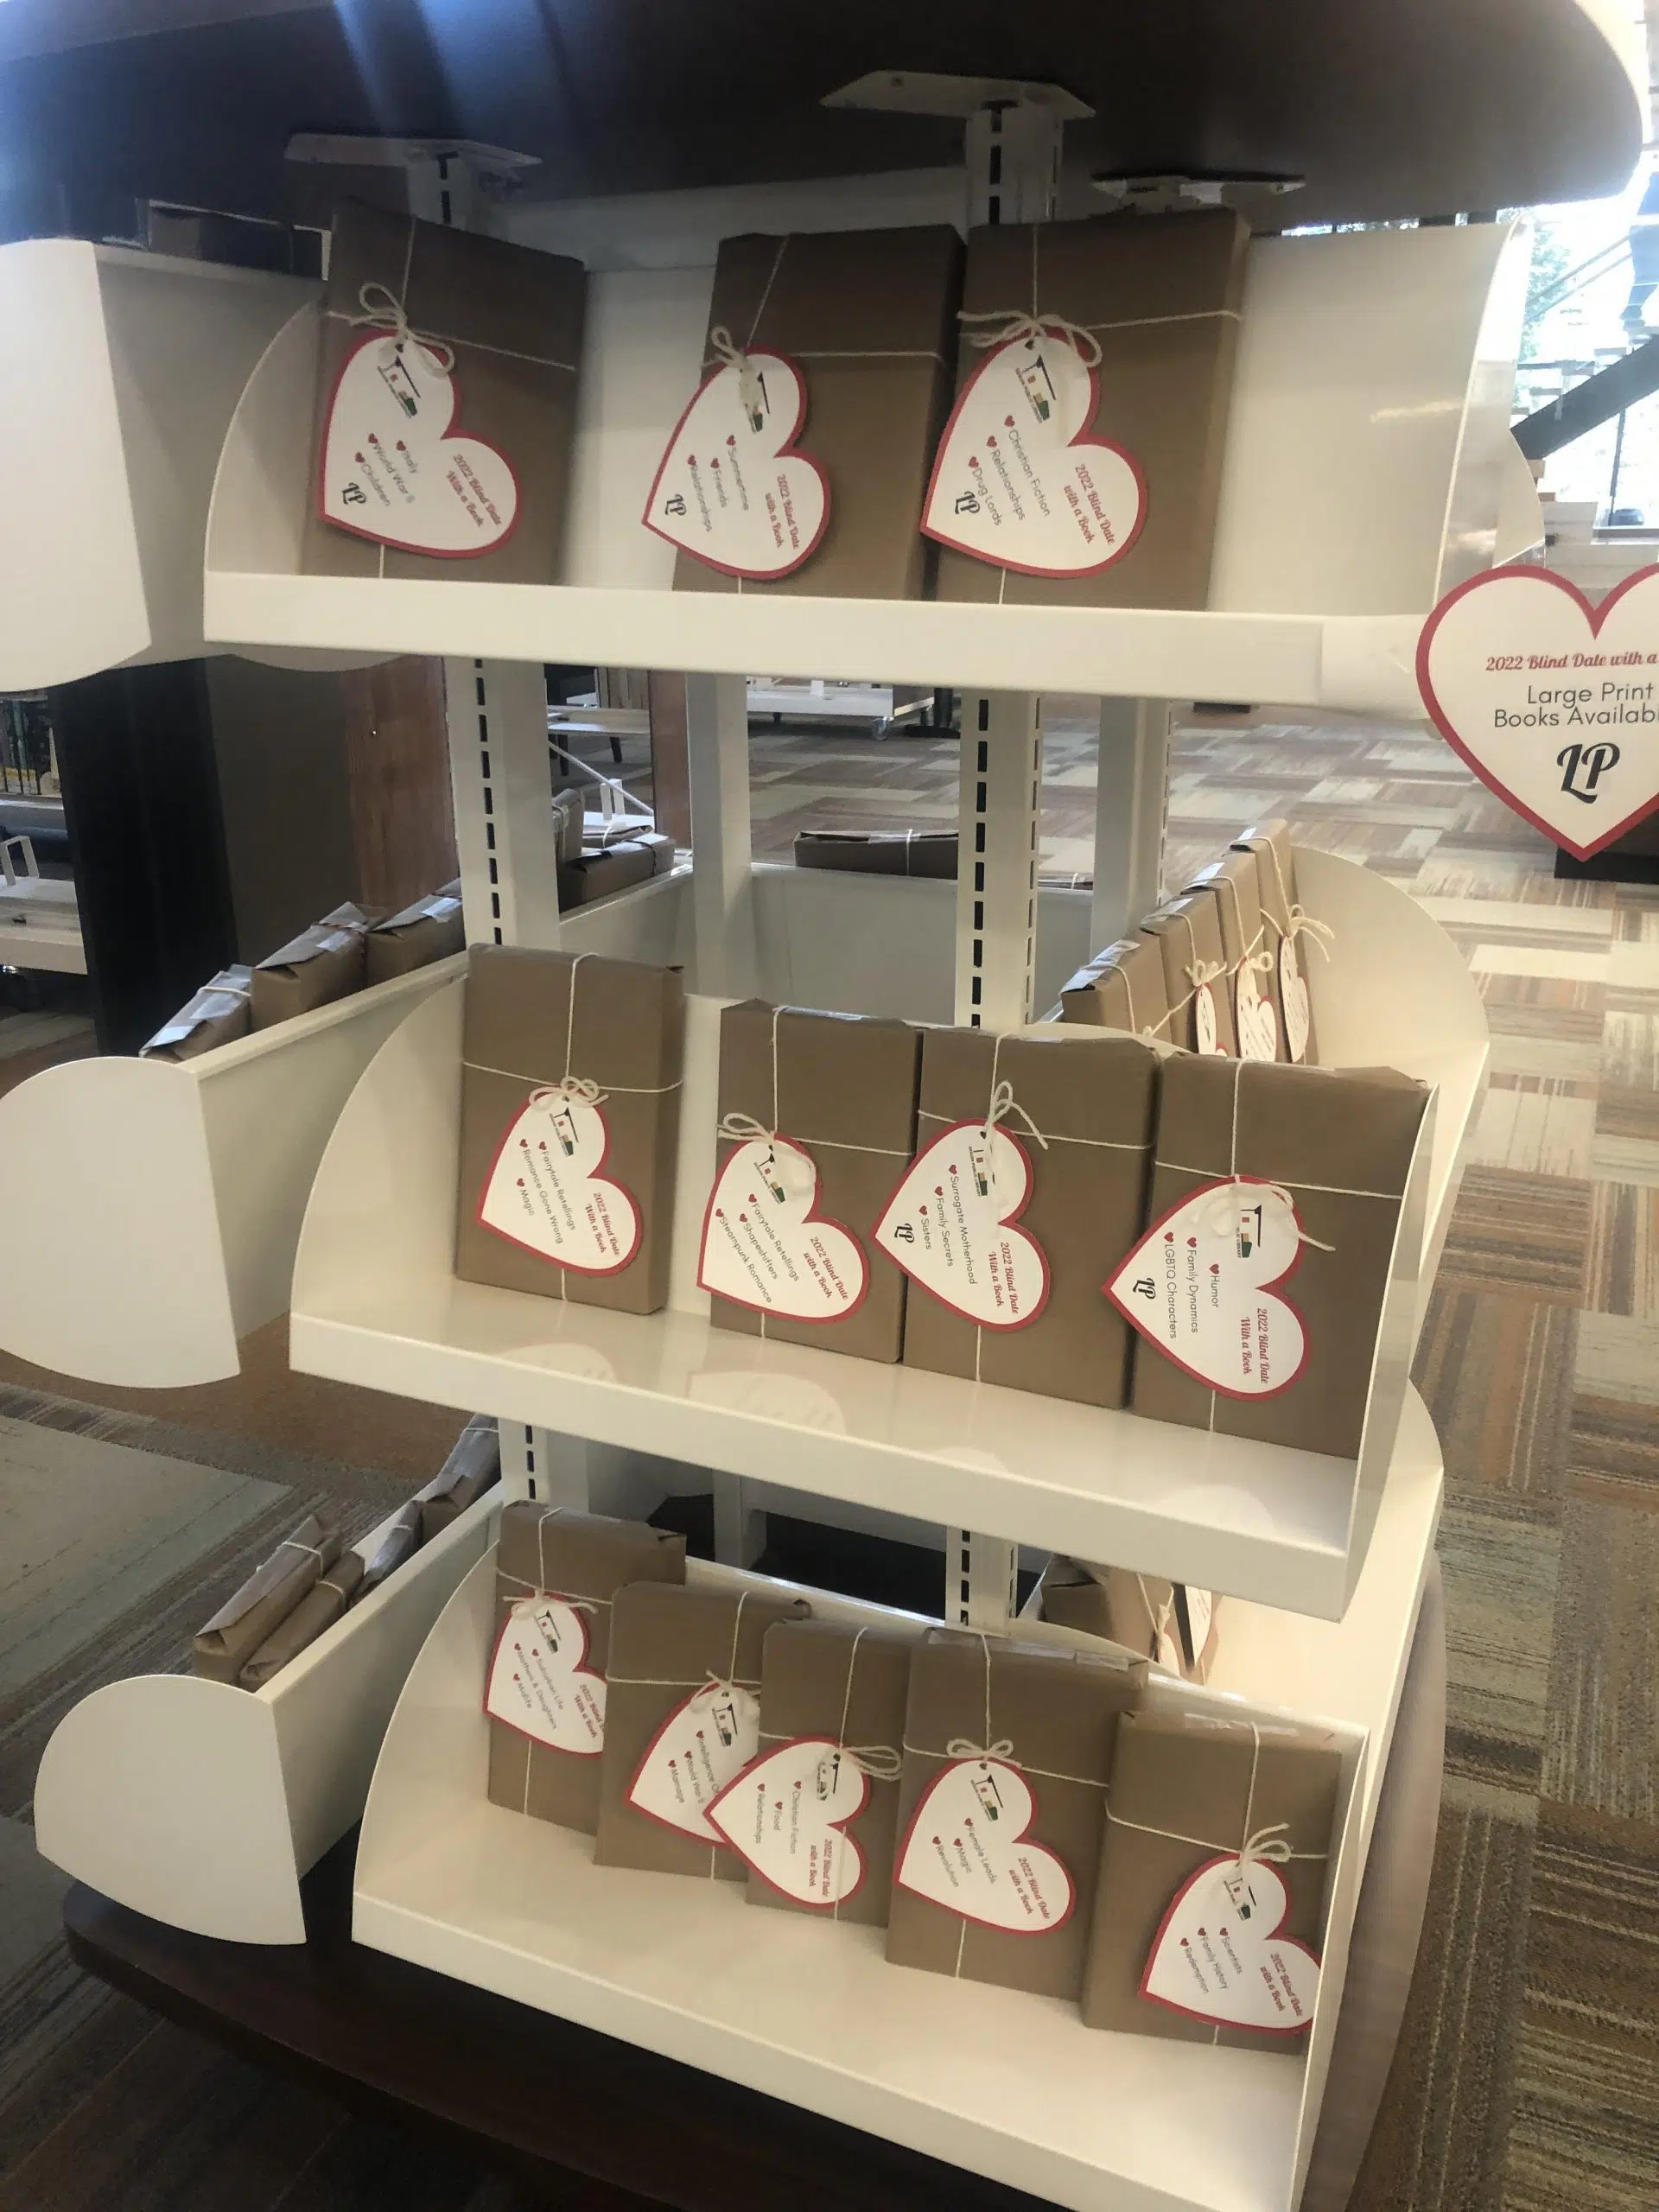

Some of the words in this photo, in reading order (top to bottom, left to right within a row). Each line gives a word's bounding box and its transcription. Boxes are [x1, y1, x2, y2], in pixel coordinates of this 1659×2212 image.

[990, 449, 1025, 520] Relationships
[1008, 429, 1033, 478] Christian
[1030, 478, 1050, 516] Fiction
[342, 483, 366, 505] LP
[664, 494, 687, 516] LP
[955, 491, 980, 515] LP
[972, 467, 988, 496] Drug
[985, 495, 1002, 525] Lords
[1076, 464, 1093, 491] 2022
[1088, 491, 1106, 520] Blind
[1100, 519, 1115, 544] Date
[1064, 486, 1078, 508] with
[1078, 516, 1095, 543] Book
[1486, 656, 1523, 671] 2022
[1528, 655, 1567, 670] Blind
[1573, 653, 1606, 667] Date
[1611, 652, 1643, 666] with
[1647, 653, 1657, 664] a
[1528, 685, 1592, 709] Large
[1602, 683, 1654, 701] Print
[1494, 707, 1559, 728] Books
[1557, 742, 1620, 804] LP
[520, 1190, 534, 1215] Magic
[522, 1149, 542, 1188] Romance
[539, 1191, 551, 1214] Gone
[550, 1216, 563, 1243] Wrong
[541, 1151, 559, 1187] Fairytale
[556, 1189, 575, 1230] Retellings
[585, 1204, 596, 1224] With
[595, 1232, 606, 1253] Book
[594, 1192, 607, 1212] 2022
[601, 1214, 614, 1236] Blind
[610, 1237, 620, 1255] Date
[937, 1198, 949, 1228] Family
[950, 1176, 963, 1224] Surrogate
[960, 1227, 977, 1284] Motherhood
[743, 1223, 778, 1279] Shapeshifters
[752, 1204, 774, 1239] Fairytale
[774, 1240, 799, 1281] Retellings
[894, 1224, 914, 1243] LP
[921, 1218, 931, 1249] Sisters
[942, 1230, 953, 1266] Secrets
[720, 1217, 750, 1263] Steampunk
[747, 1263, 772, 1302] Romance
[810, 1237, 826, 1258] 2022
[823, 1258, 839, 1281] Blind
[836, 1281, 848, 1299] Date
[1001, 1243, 1012, 1264] 2022
[1165, 1244, 1176, 1279] LGBTQ
[1185, 1250, 1198, 1281] Family
[804, 1253, 817, 1269] with
[818, 1277, 832, 1298] Book
[988, 1252, 998, 1274] With
[994, 1284, 1004, 1306] Book
[1005, 1267, 1016, 1292] Blind
[1133, 1278, 1156, 1300] LP
[1211, 1275, 1220, 1307] Humor
[1009, 1294, 1019, 1313] Date
[1167, 1282, 1178, 1338] Characters
[1186, 1286, 1198, 1332] Dynamics
[1257, 1308, 1268, 1332] 2022
[1241, 1317, 1250, 1340] With
[1243, 1351, 1252, 1375] Book
[1259, 1334, 1268, 1360] Blind
[1261, 1363, 1269, 1383] Date
[936, 1844, 958, 1887] Revolution
[956, 1846, 971, 1873] Magic
[967, 1826, 984, 1857] Female
[982, 1859, 997, 1884] Leads
[1009, 1870, 1021, 1886] with
[1020, 1894, 1033, 1914] Book
[1018, 1858, 1033, 1877] 2022
[1028, 1878, 1042, 1900] Blind
[1039, 1901, 1050, 1919] Date
[1271, 1954, 1286, 1973] 2022
